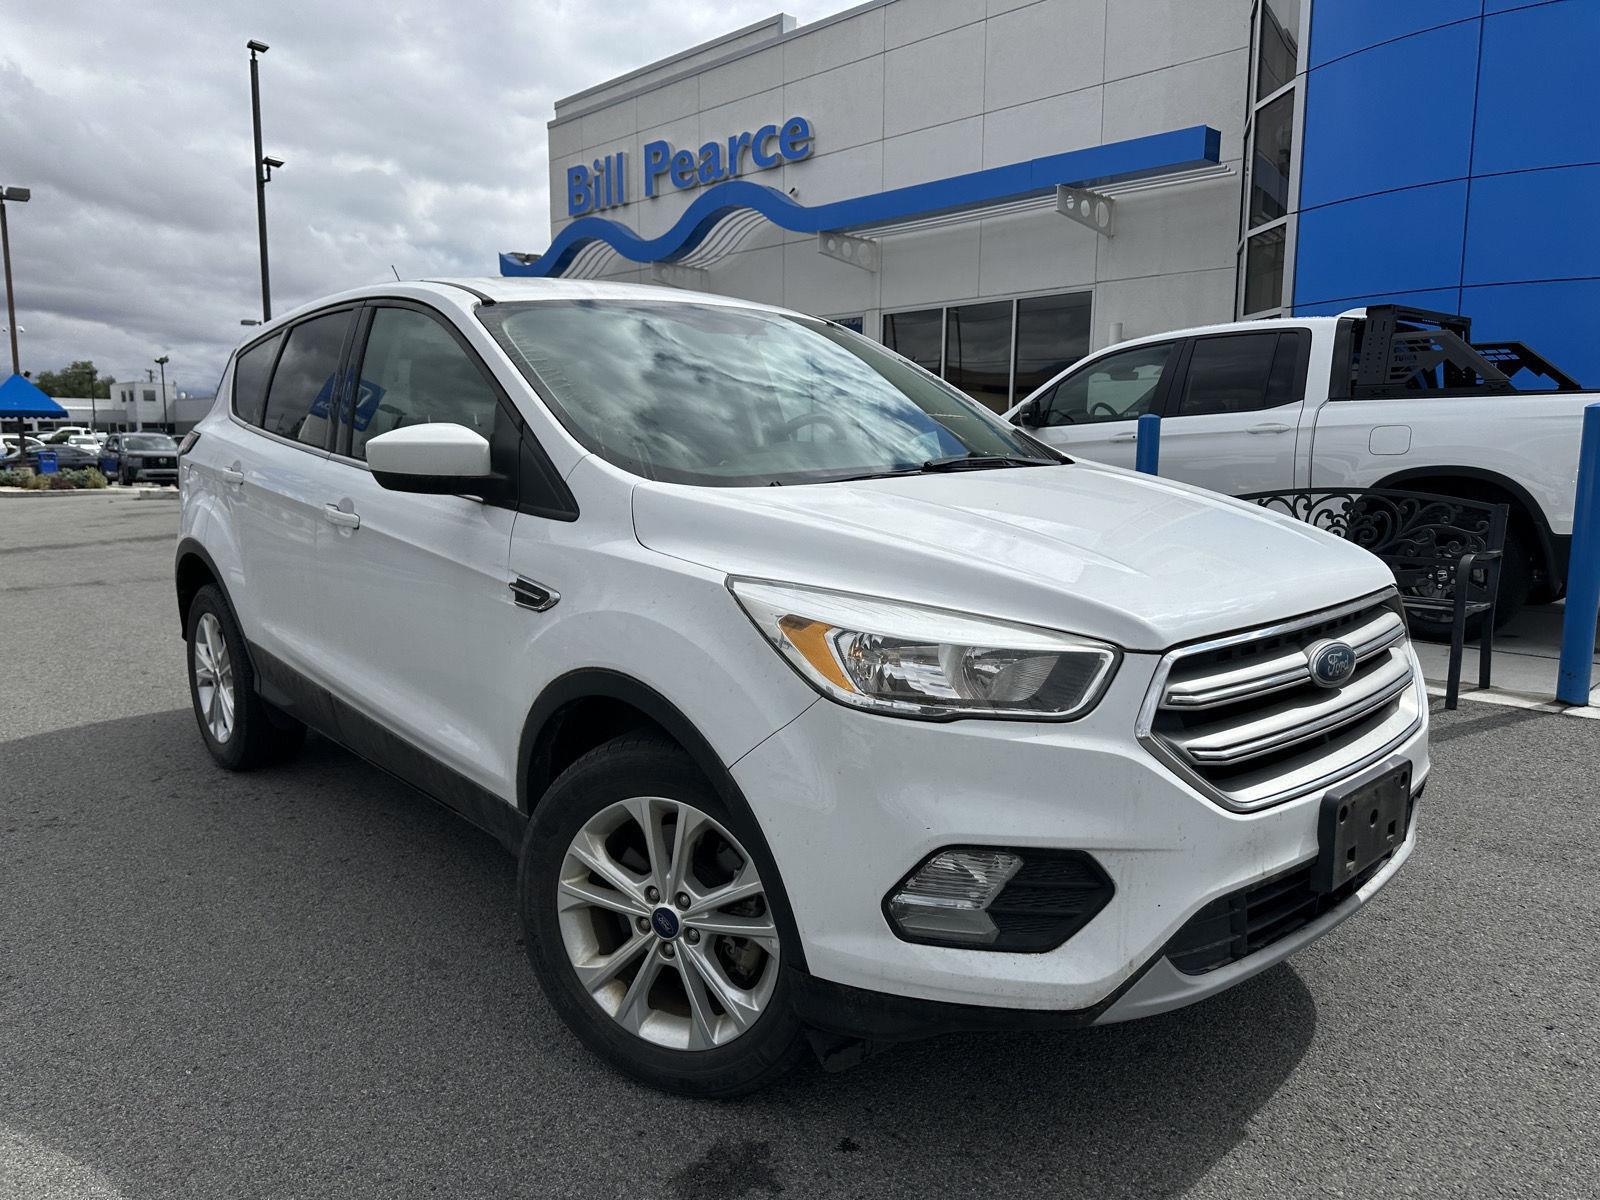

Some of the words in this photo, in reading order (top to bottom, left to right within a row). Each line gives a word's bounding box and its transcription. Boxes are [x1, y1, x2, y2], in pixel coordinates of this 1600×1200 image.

[567, 151, 627, 217] Bill
[644, 116, 813, 198] Pearce
[1327, 651, 1349, 676] Ford
